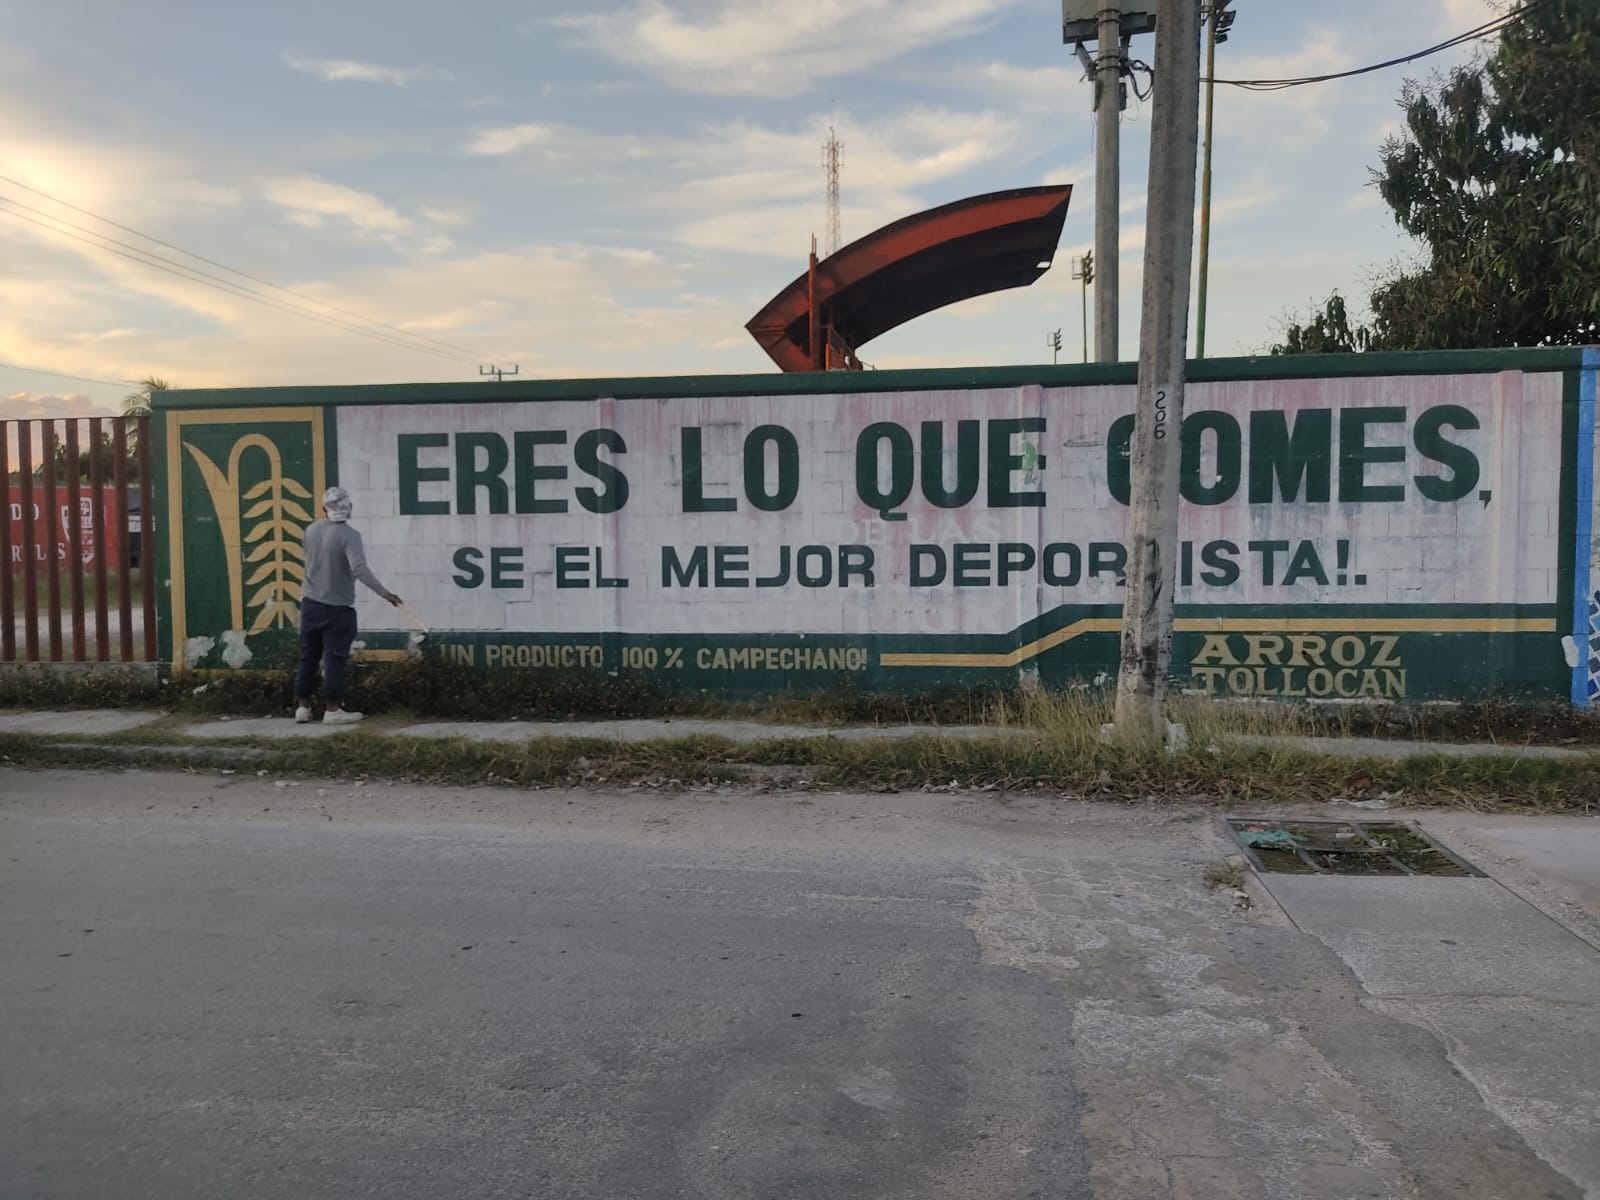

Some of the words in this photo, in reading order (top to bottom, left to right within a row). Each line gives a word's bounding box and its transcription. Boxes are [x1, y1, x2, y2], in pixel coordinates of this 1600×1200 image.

[1154, 391, 1166, 440] 206
[397, 428, 630, 516] ERES
[681, 424, 800, 513] LO
[855, 417, 1047, 521] QUE
[452, 547, 524, 589] SE
[556, 546, 629, 588] EL
[661, 544, 875, 588] MEJOR
[909, 539, 1368, 588] DEPORISTA!.
[440, 644, 475, 666] UN
[486, 645, 604, 668] PRODUCTO
[696, 647, 868, 670] CAMPECHANO!
[1189, 633, 1401, 667] ARROZ
[1191, 666, 1408, 698] TOLLOCAN
